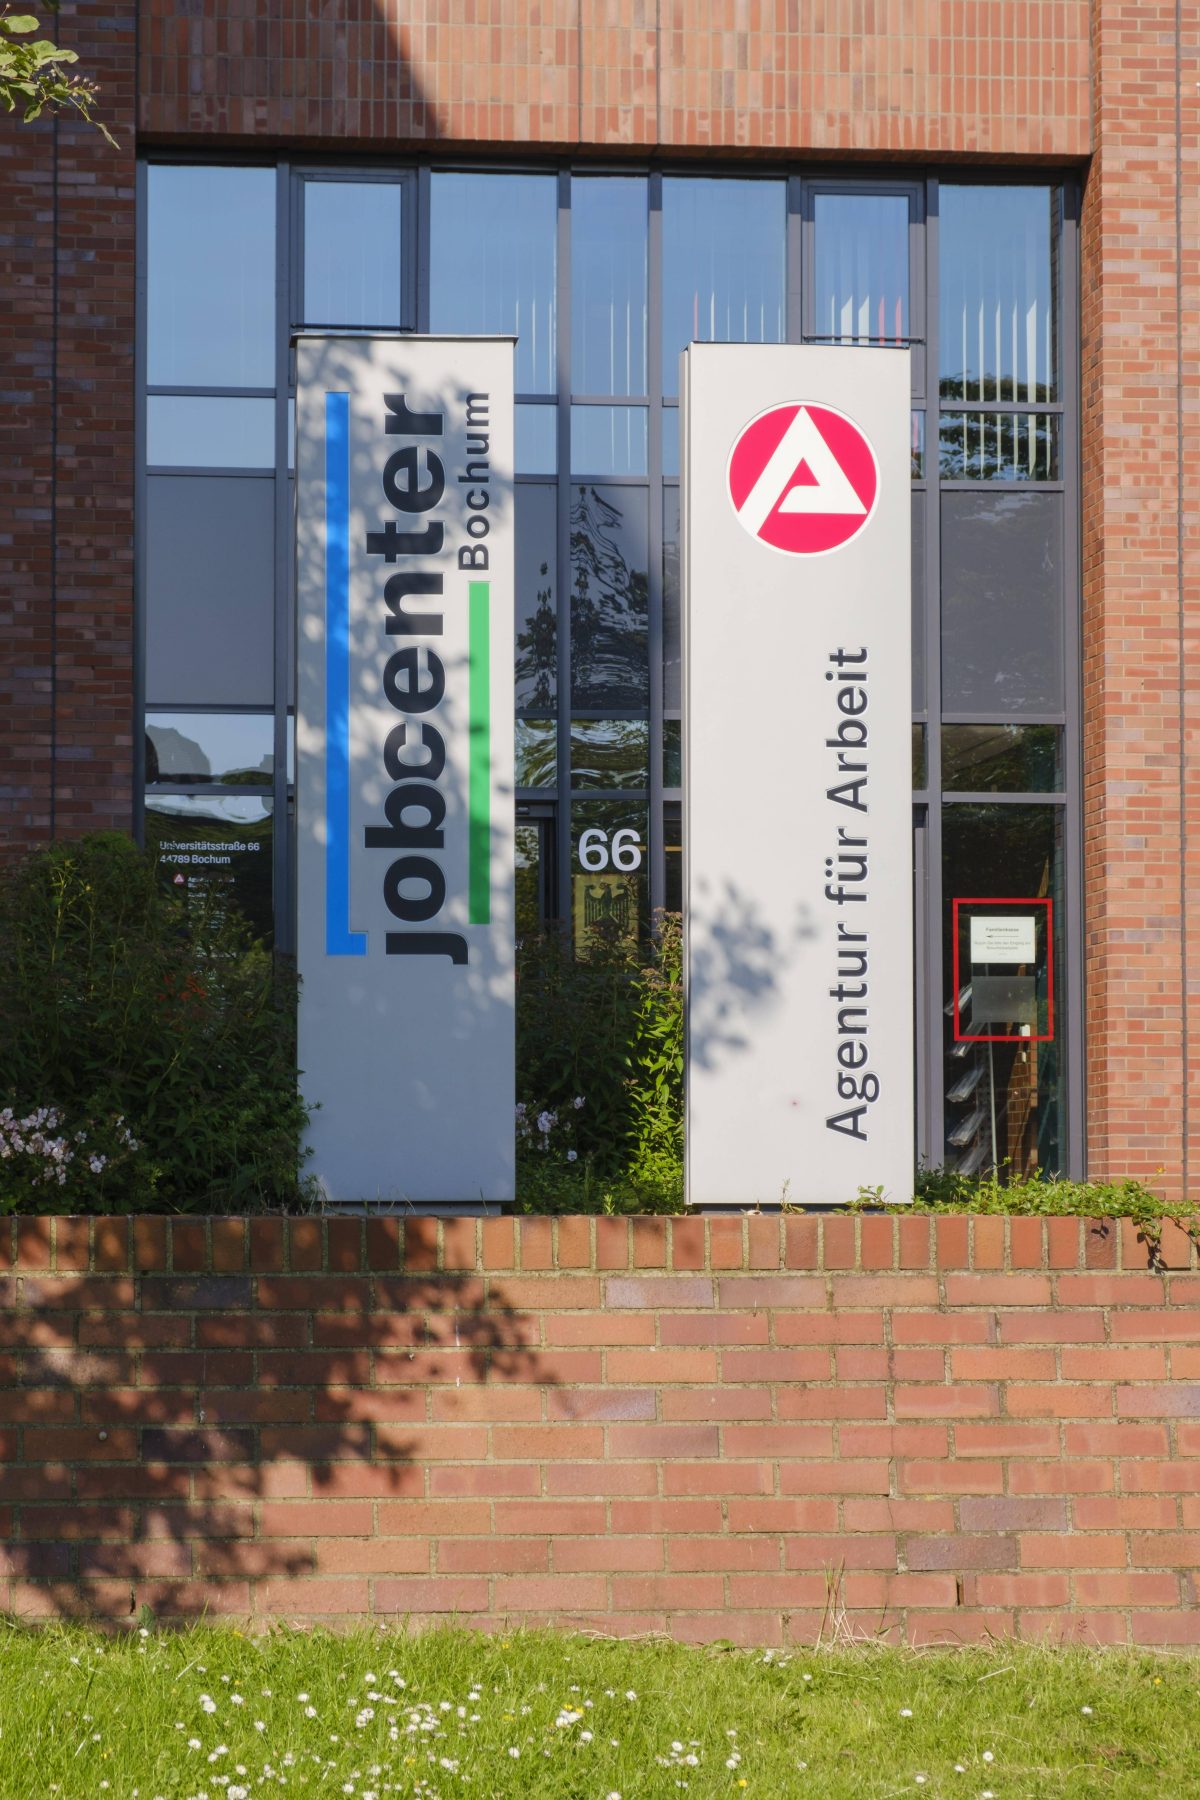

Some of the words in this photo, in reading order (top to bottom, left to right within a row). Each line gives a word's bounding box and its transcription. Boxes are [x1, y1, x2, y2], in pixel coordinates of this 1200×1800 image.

[458, 392, 490, 570] Bochum
[825, 646, 869, 813] Arbeit
[191, 854, 231, 864] Bochum
[247, 842, 260, 851] 66
[578, 828, 642, 871] 66
[825, 826, 869, 902] für
[825, 921, 880, 1141] Agentur
